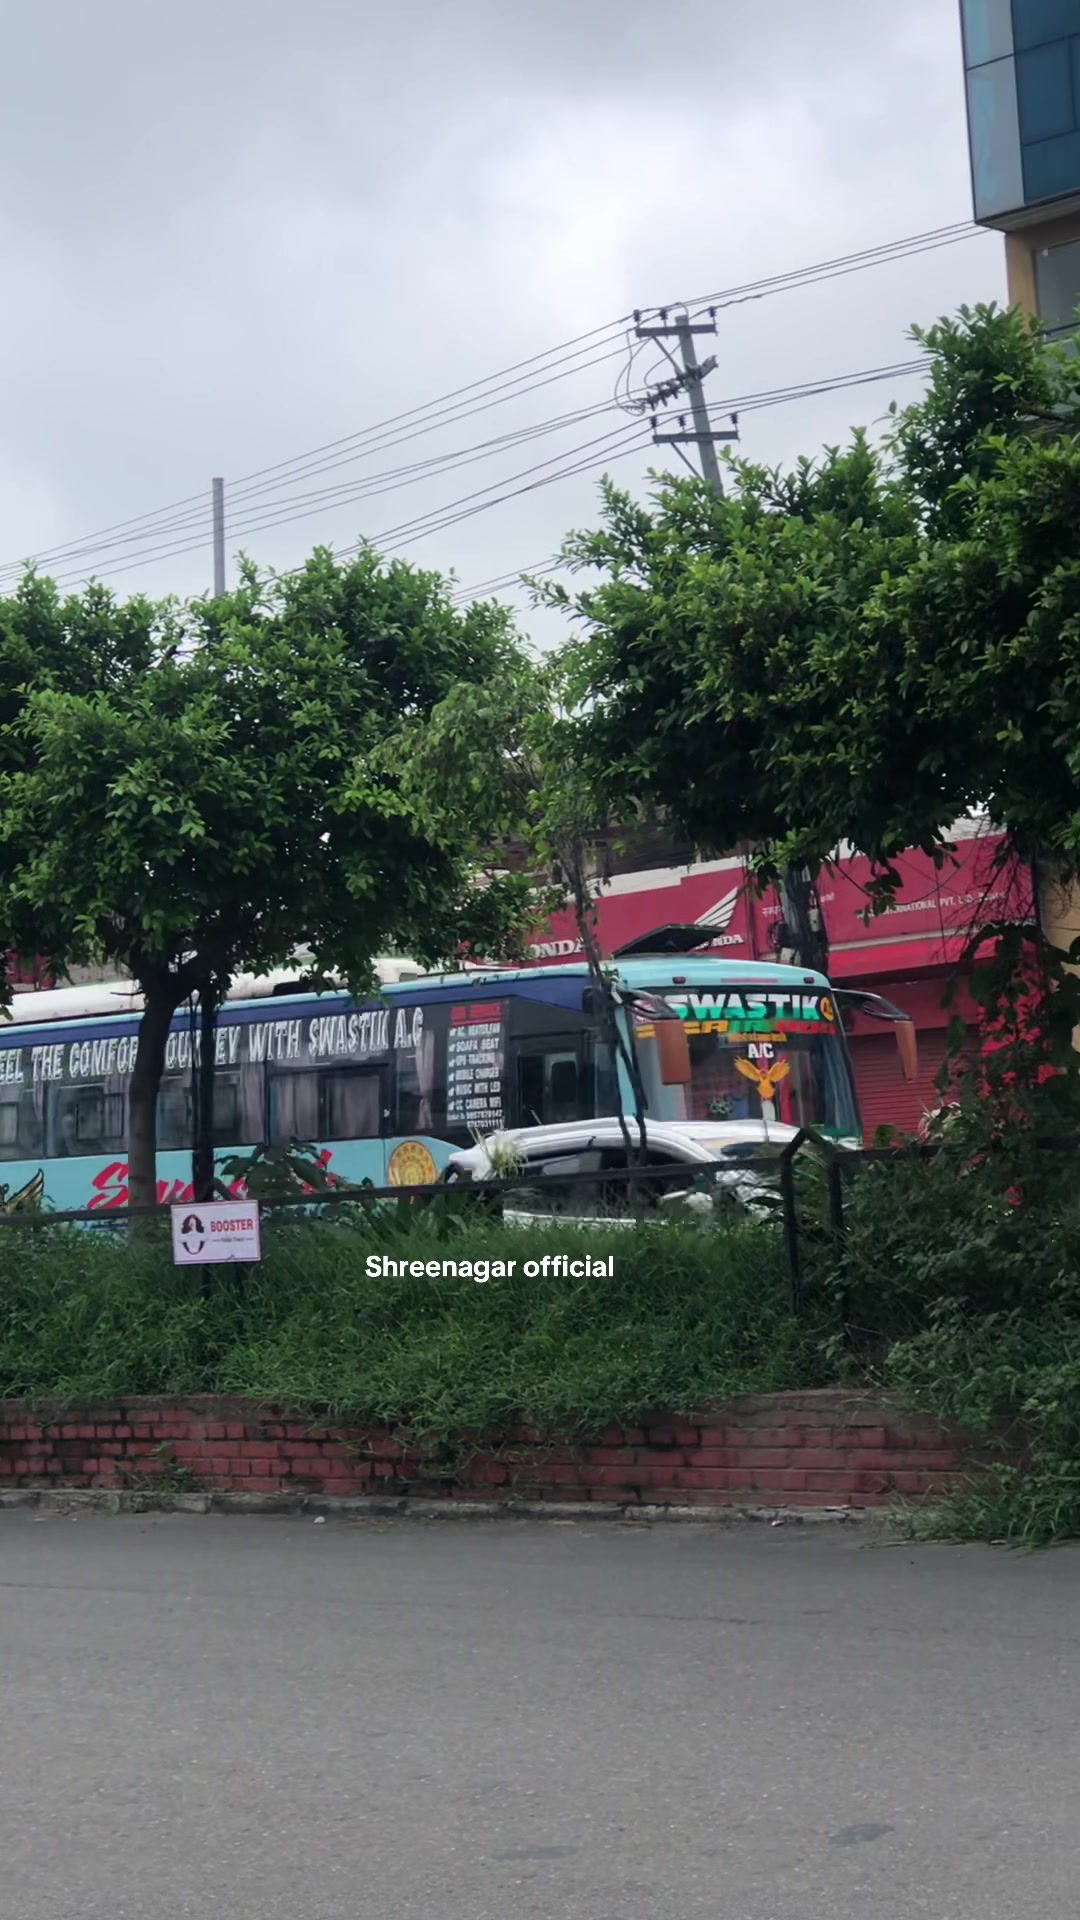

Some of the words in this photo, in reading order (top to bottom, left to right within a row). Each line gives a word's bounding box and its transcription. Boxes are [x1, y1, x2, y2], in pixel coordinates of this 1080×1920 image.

[695, 934, 744, 949] NDA
[664, 993, 819, 1020] SWASTIK
[31, 1043, 65, 1082] THE
[69, 1035, 140, 1078] COMFOR
[164, 1025, 241, 1069] OUREY
[249, 1019, 302, 1062] WITH
[308, 1010, 391, 1056] SWASTIK
[748, 1043, 775, 1059] A/C
[490, 1081, 501, 1093] LED
[465, 1098, 487, 1110] CAMERA
[210, 1219, 254, 1233] BOOSTER
